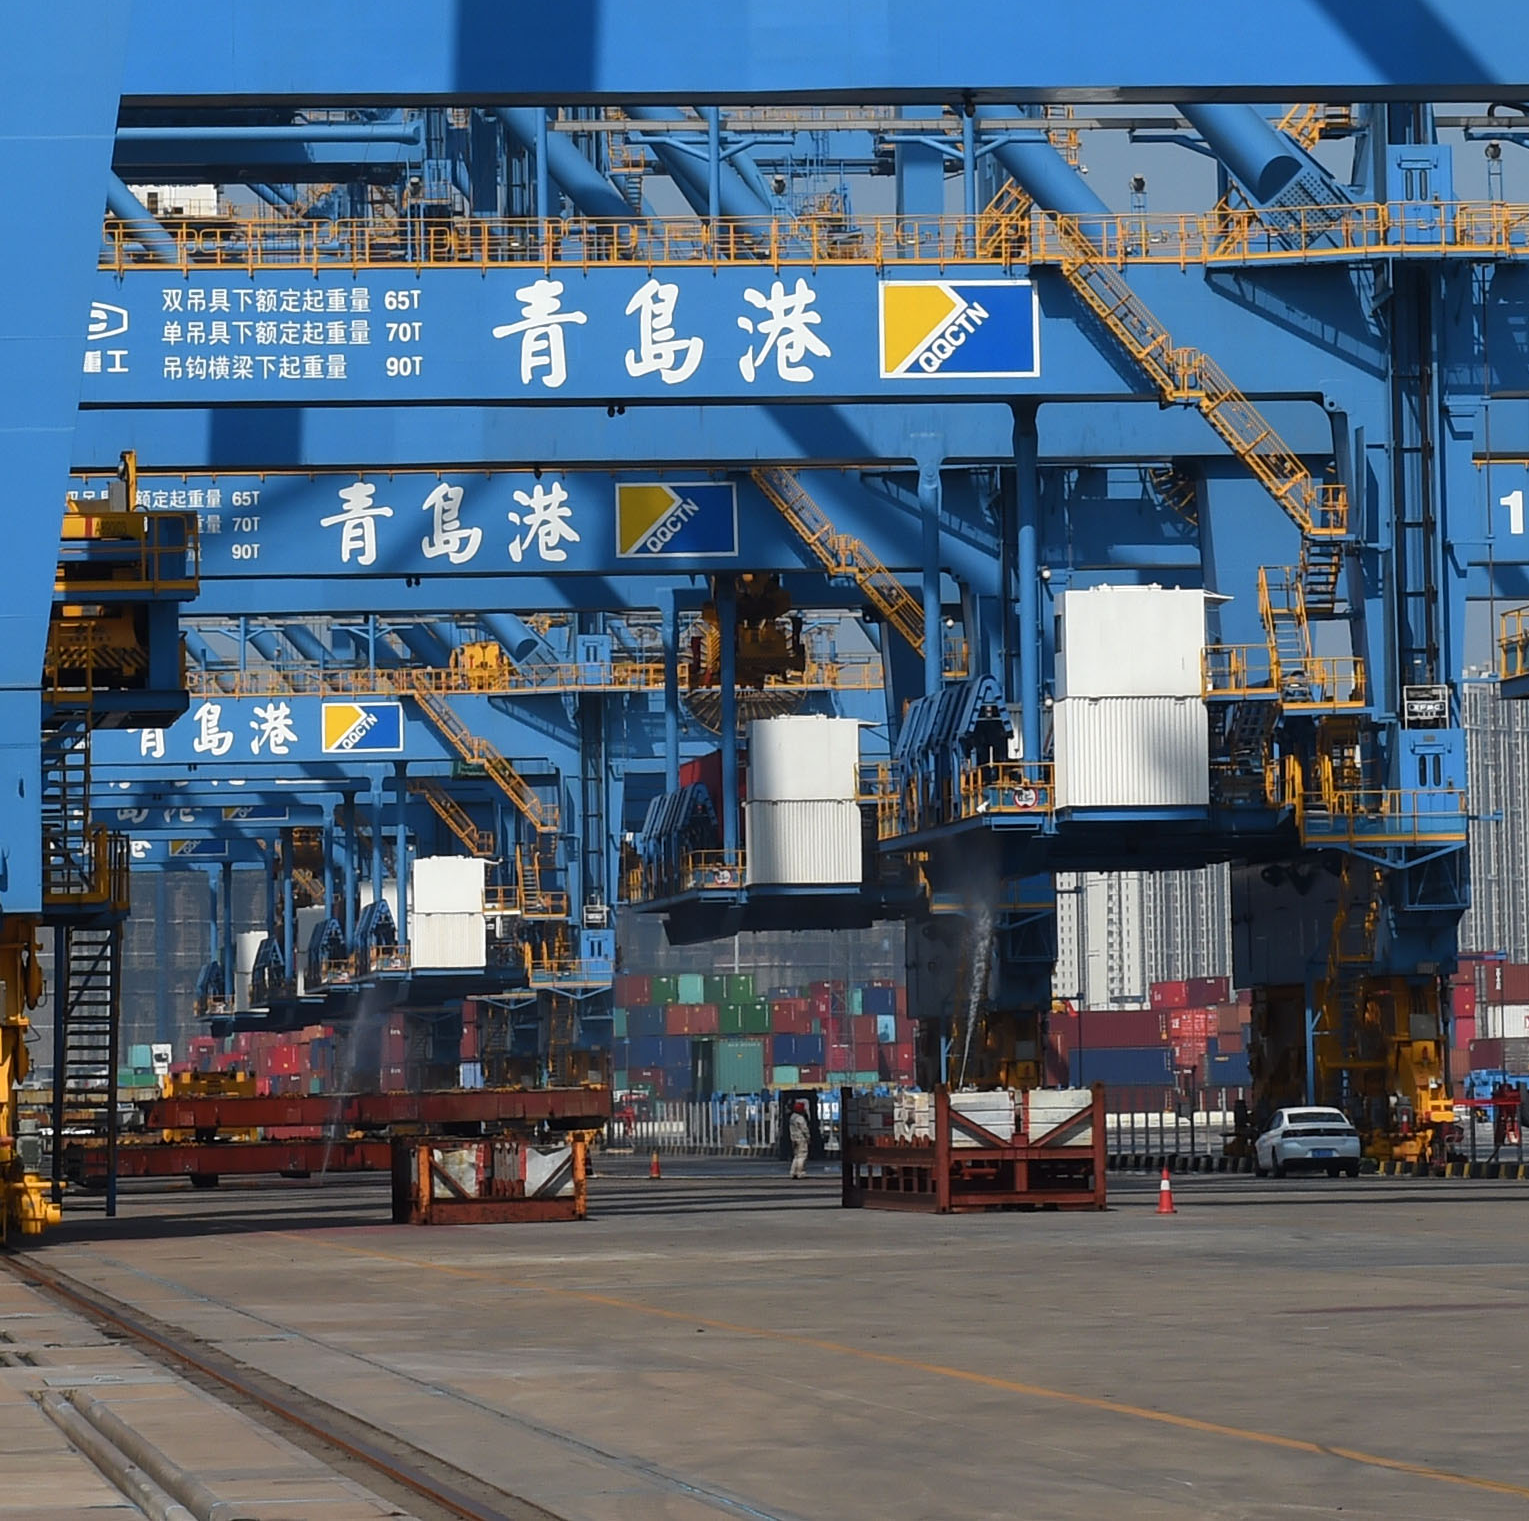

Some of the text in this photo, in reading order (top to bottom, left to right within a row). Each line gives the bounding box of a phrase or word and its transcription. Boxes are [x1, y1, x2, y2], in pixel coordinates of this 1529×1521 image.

[162, 287, 422, 313] 双吊具下额定起重量 65T
[161, 319, 423, 346] 单吊具下额定起重量 70T
[492, 277, 832, 388] 青島港
[917, 300, 990, 373] QQCTN
[163, 354, 423, 380] 吊钩横梁下起重量 90T
[231, 490, 261, 507] 65T
[231, 516, 261, 533] 70T
[320, 481, 581, 566] 青島港
[646, 497, 700, 554] QQCTN
[231, 543, 261, 560] 90T
[341, 713, 378, 749] QQCTN
